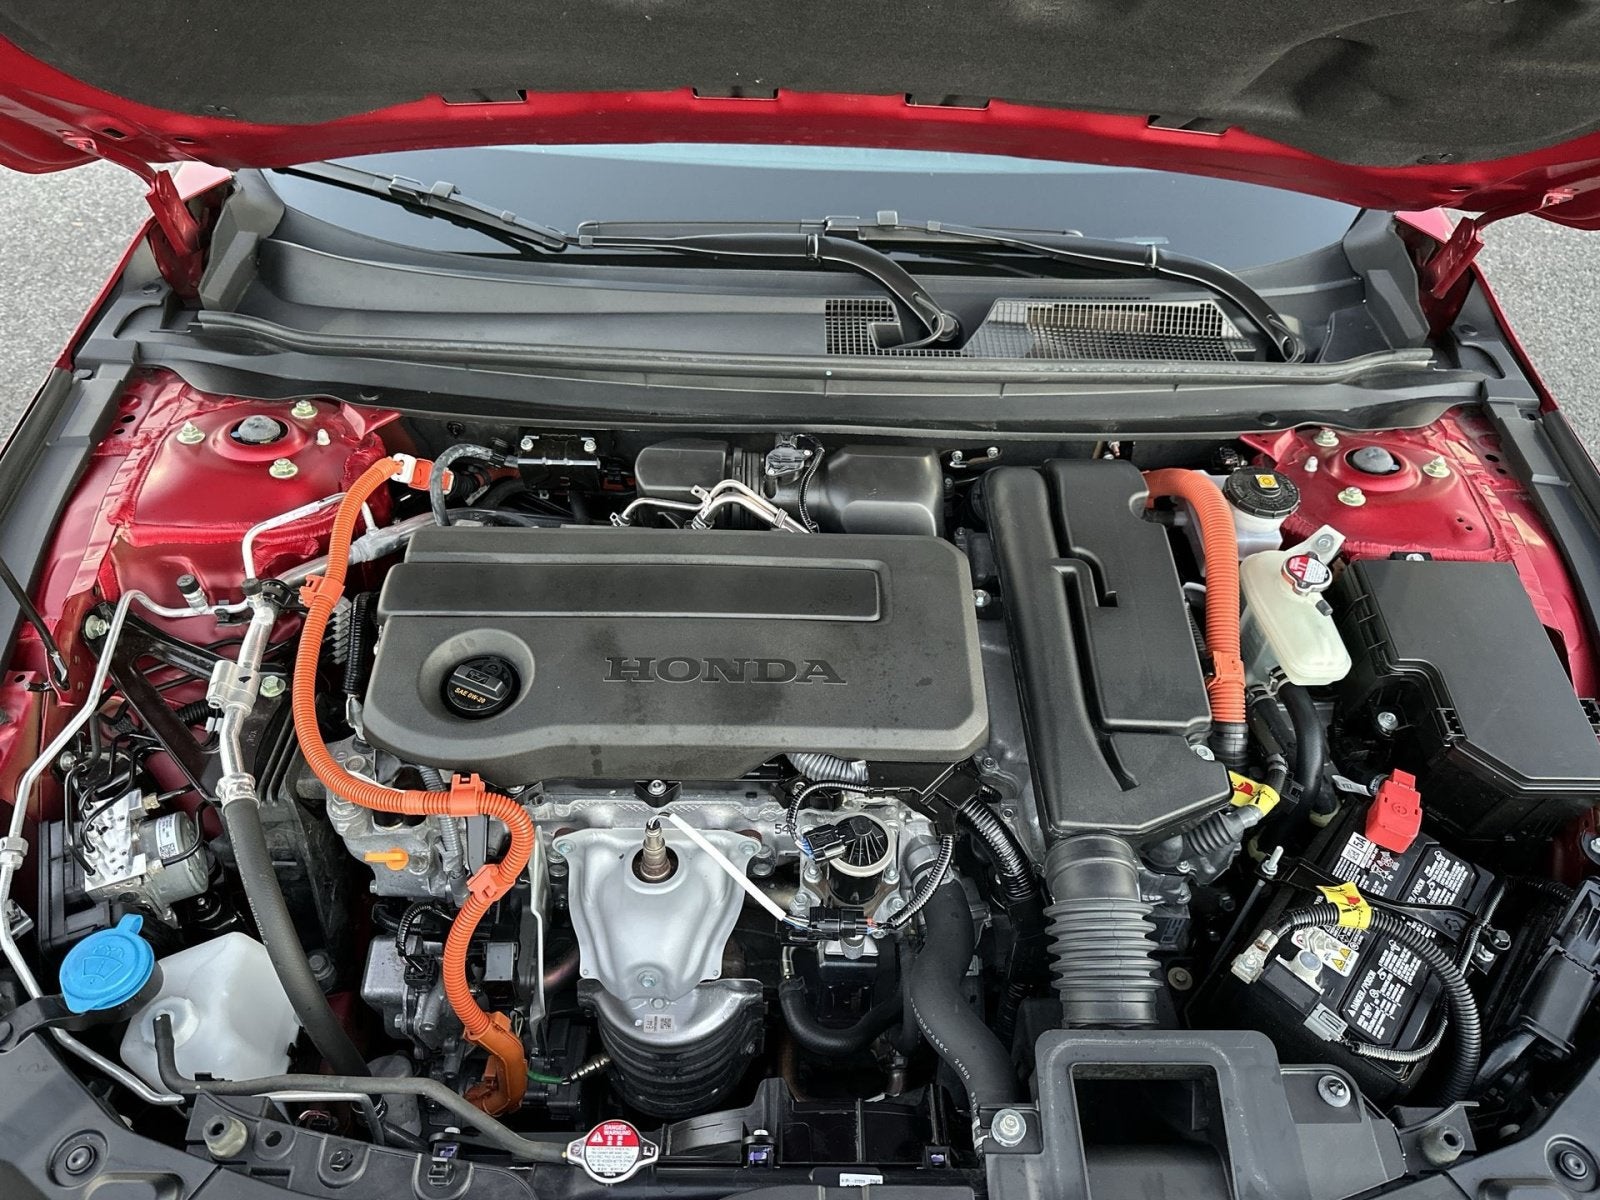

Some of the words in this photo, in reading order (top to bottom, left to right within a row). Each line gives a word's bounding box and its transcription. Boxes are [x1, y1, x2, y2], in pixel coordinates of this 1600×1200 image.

[602, 656, 848, 685] HONDA
[454, 687, 468, 697] SAE
[467, 693, 486, 704] 0W-20
[1353, 836, 1367, 849] 5A
